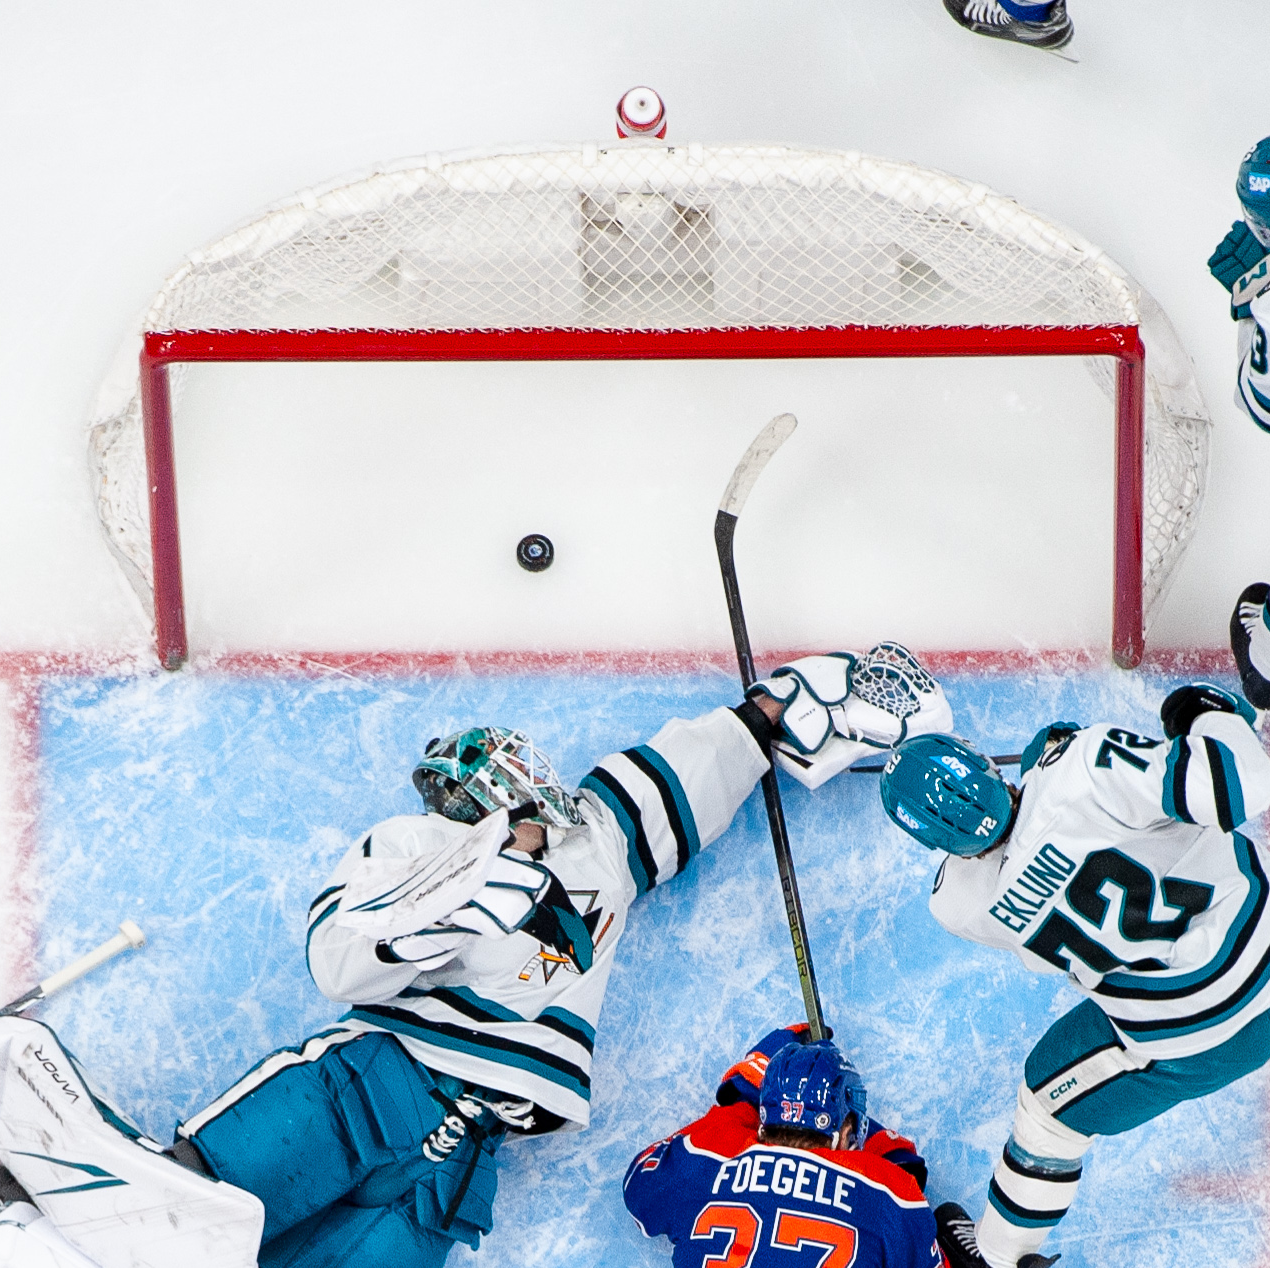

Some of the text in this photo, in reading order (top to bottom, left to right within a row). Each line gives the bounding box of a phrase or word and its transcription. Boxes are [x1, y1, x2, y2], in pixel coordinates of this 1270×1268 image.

[940, 754, 972, 781] SAP
[896, 804, 922, 830] SAP
[975, 816, 998, 838] 72
[989, 843, 1077, 934] EKLUND
[1023, 847, 1215, 973] 72
[781, 876, 809, 979] RIBCOR
[34, 1044, 80, 1105] VAPOR
[1049, 1077, 1078, 1101] CCM
[781, 1100, 805, 1123] 37
[712, 1154, 857, 1214] FOEGELE
